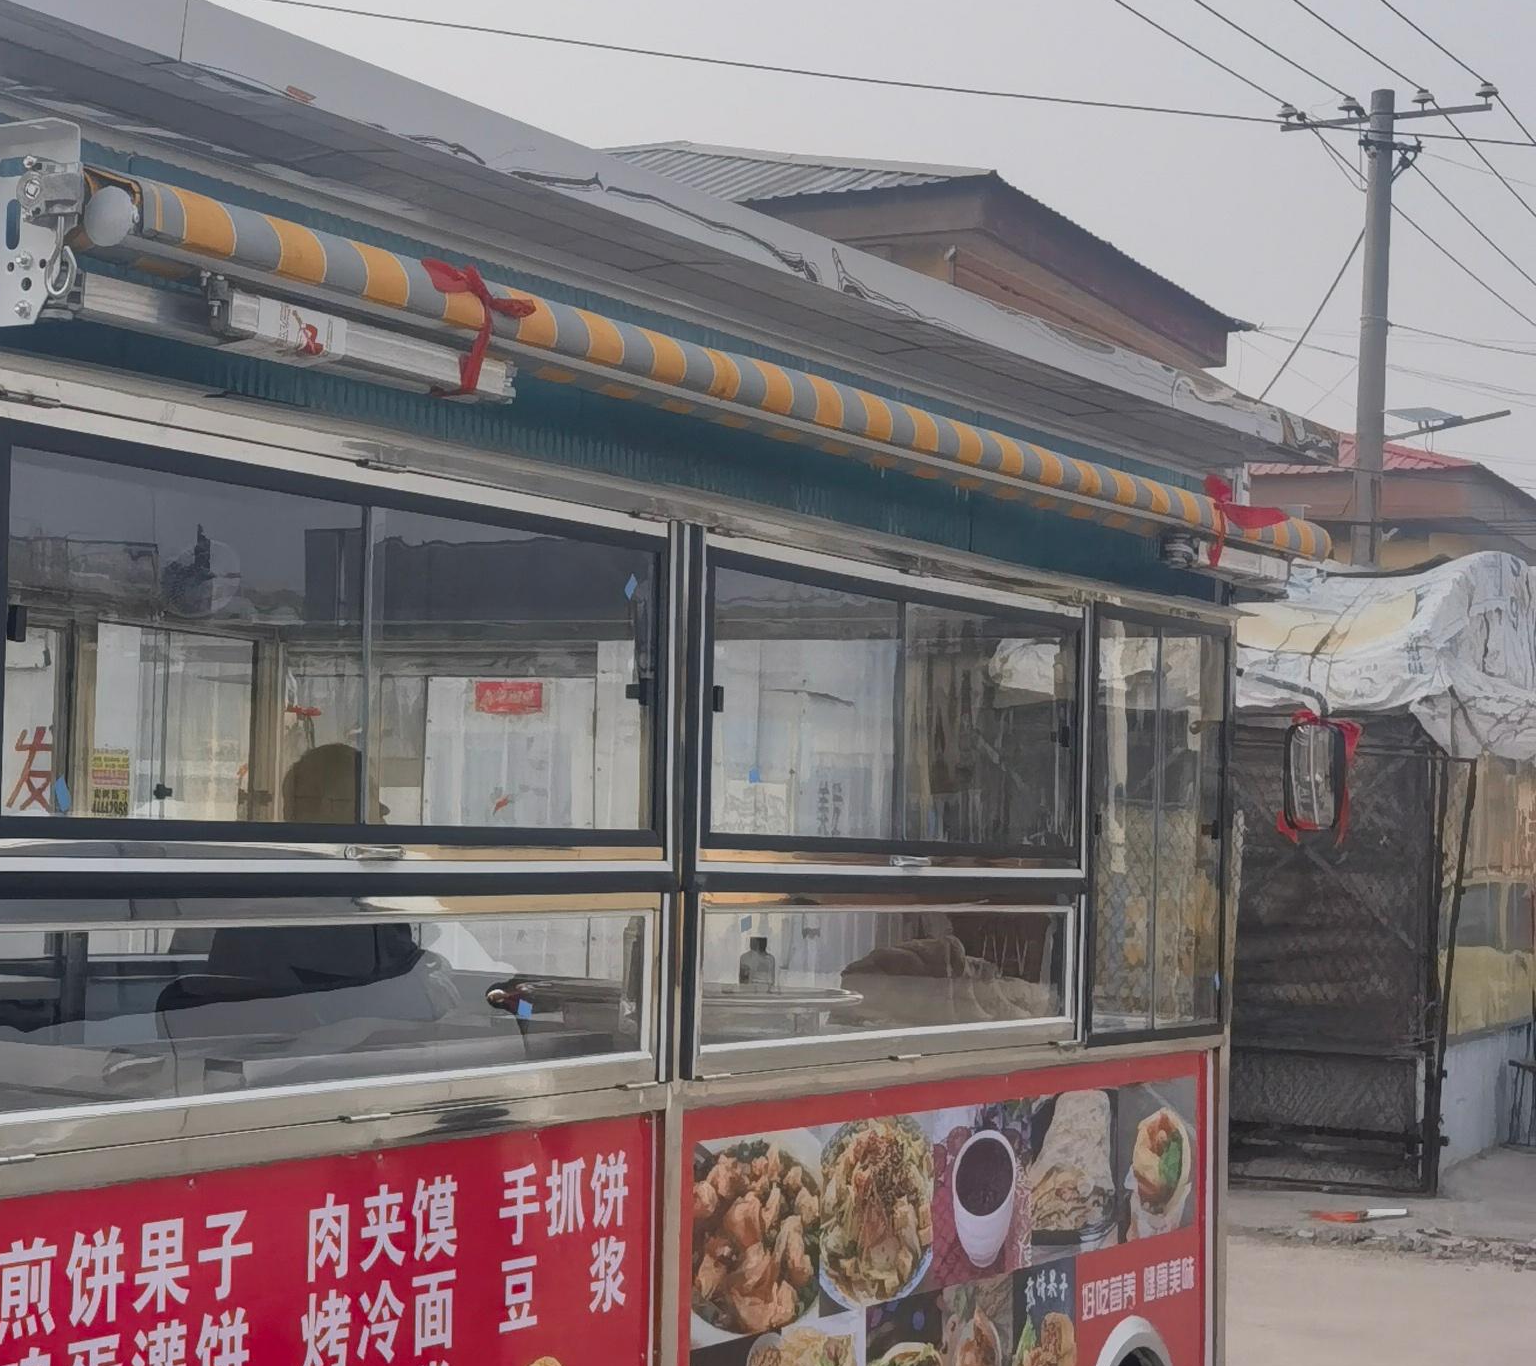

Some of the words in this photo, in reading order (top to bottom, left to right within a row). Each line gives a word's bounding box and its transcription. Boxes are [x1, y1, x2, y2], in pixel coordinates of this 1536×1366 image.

[308, 1175, 457, 1282] 肉夹馍
[499, 1150, 628, 1245] 手抓饼
[1082, 1271, 1137, 1321] 好吃营养
